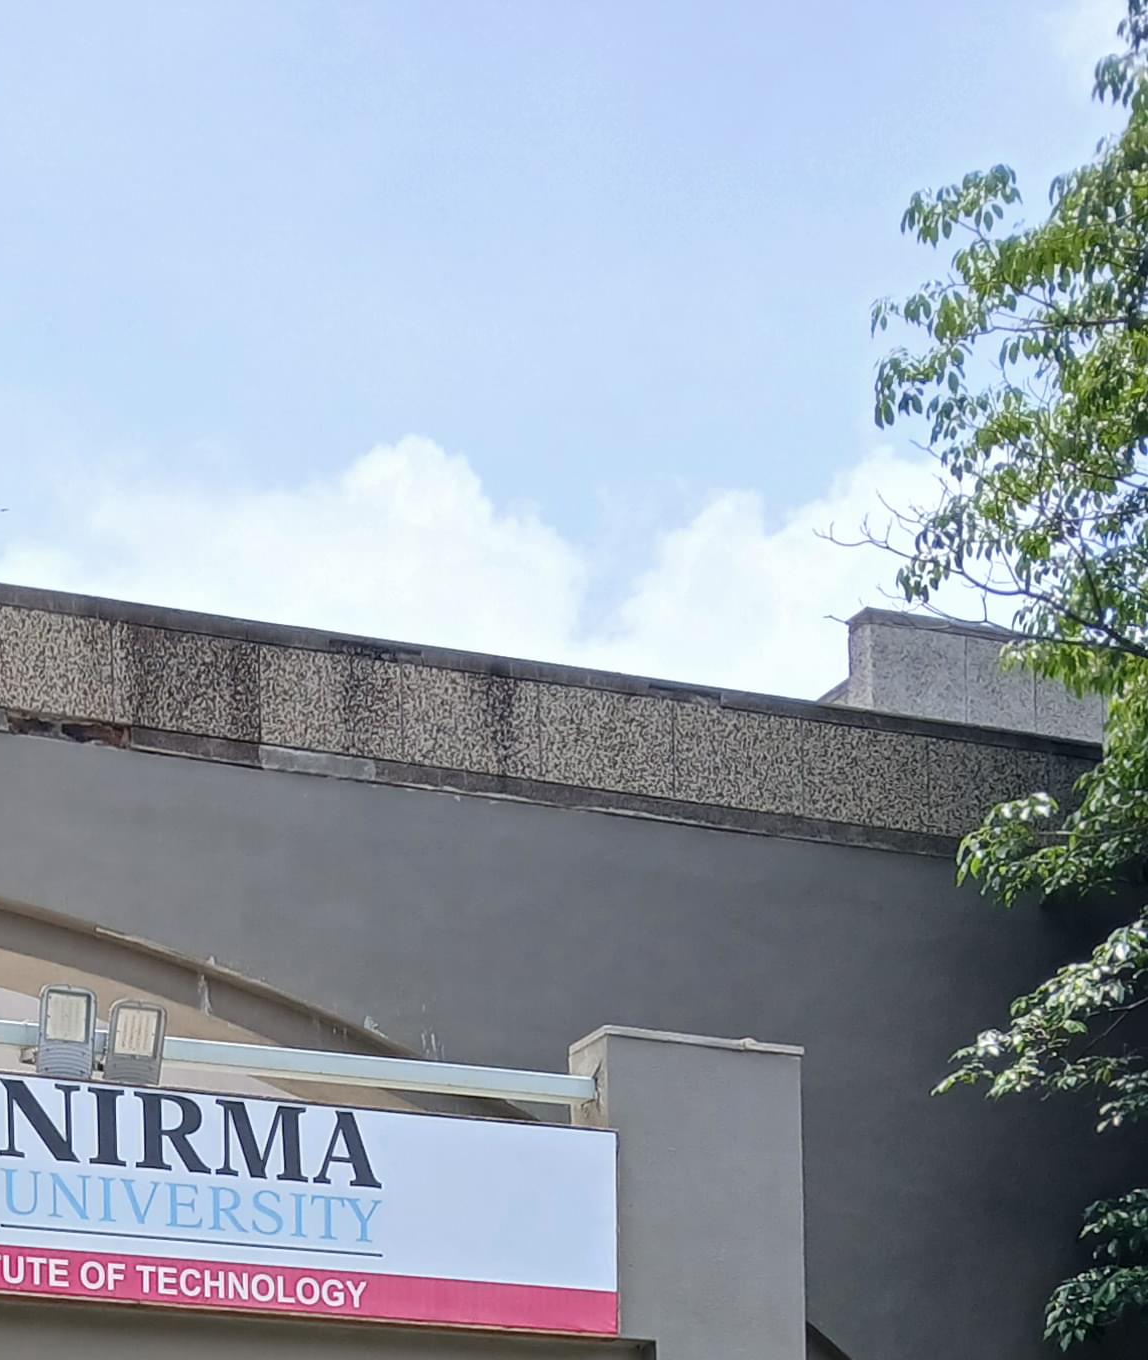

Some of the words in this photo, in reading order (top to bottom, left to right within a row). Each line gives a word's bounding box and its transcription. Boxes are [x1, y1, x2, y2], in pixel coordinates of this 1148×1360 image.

[0, 1078, 382, 1189] NIRMA
[0, 1168, 383, 1243] UNIVERSITY
[80, 1260, 129, 1293] OF
[136, 1264, 367, 1309] TECHNOLOGY
